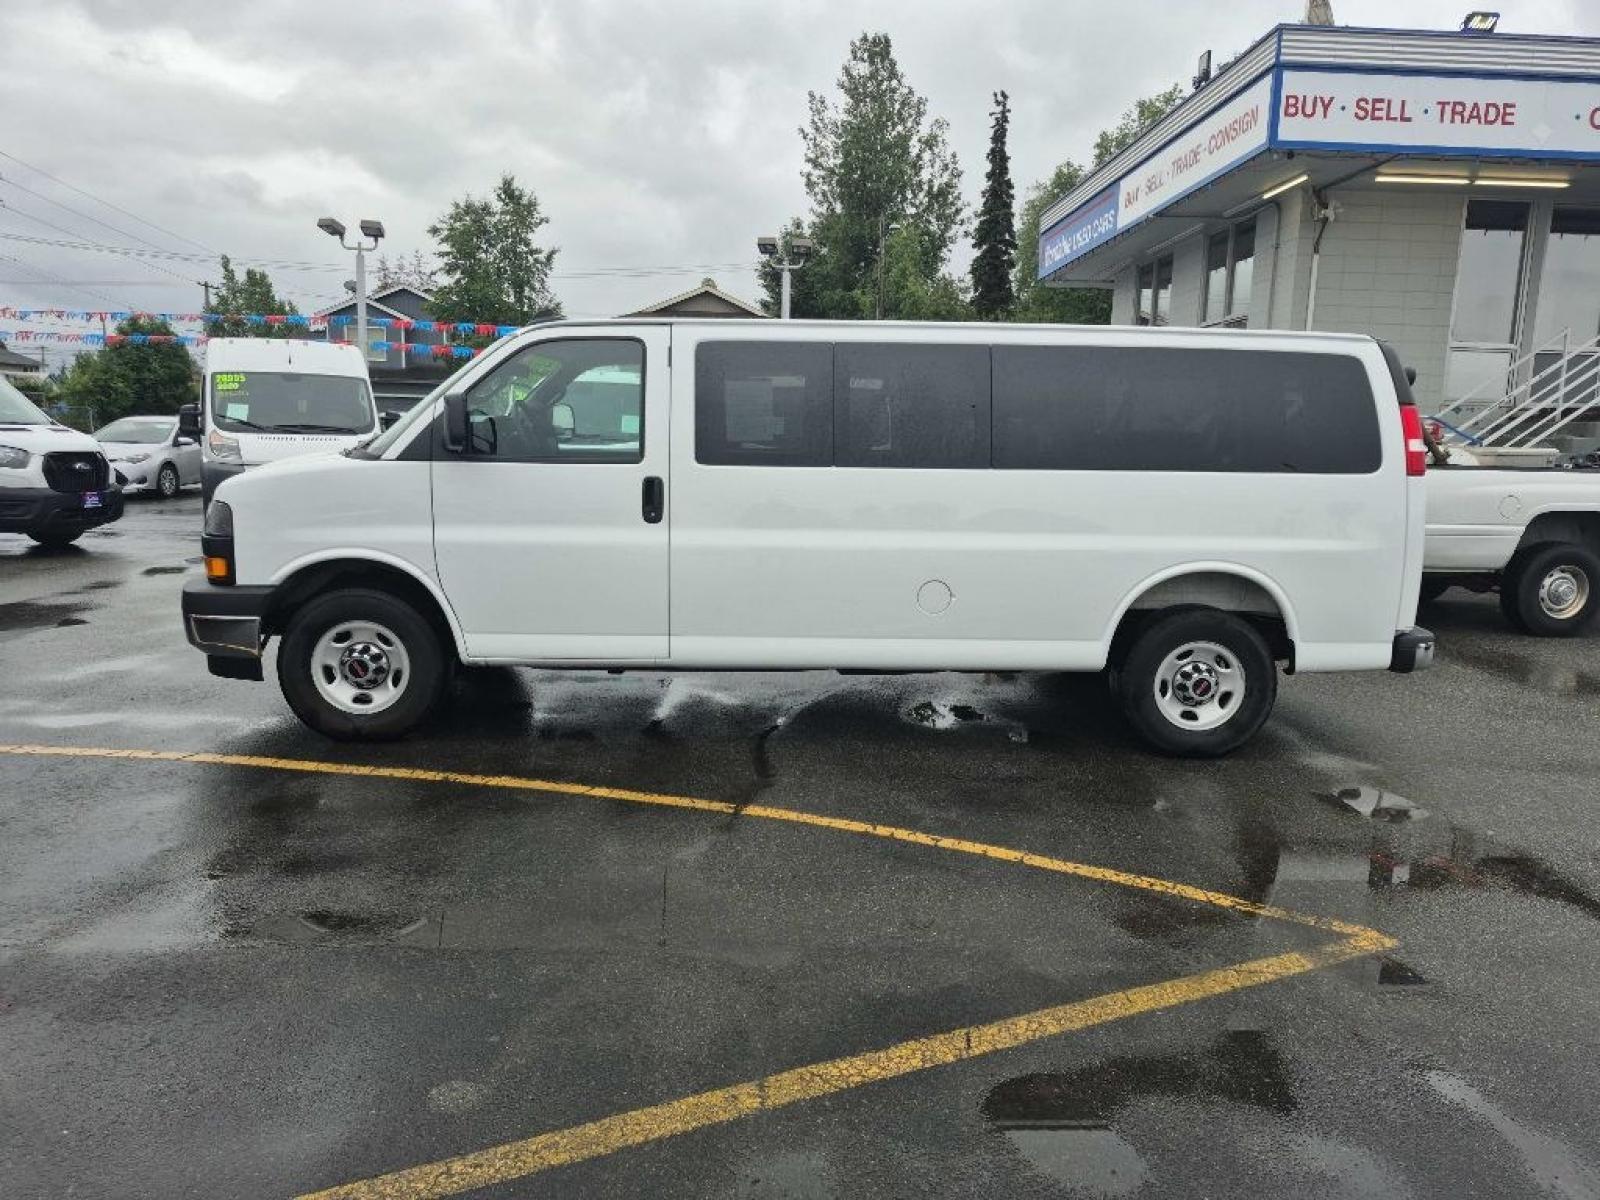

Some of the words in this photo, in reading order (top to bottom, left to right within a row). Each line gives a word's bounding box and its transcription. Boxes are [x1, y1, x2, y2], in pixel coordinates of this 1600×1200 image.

[1284, 94, 1335, 119] BUY
[1354, 97, 1412, 122] SELL
[1436, 100, 1517, 126] TRADE
[1172, 144, 1202, 177] TRADE
[1208, 105, 1259, 155] CONSIGN
